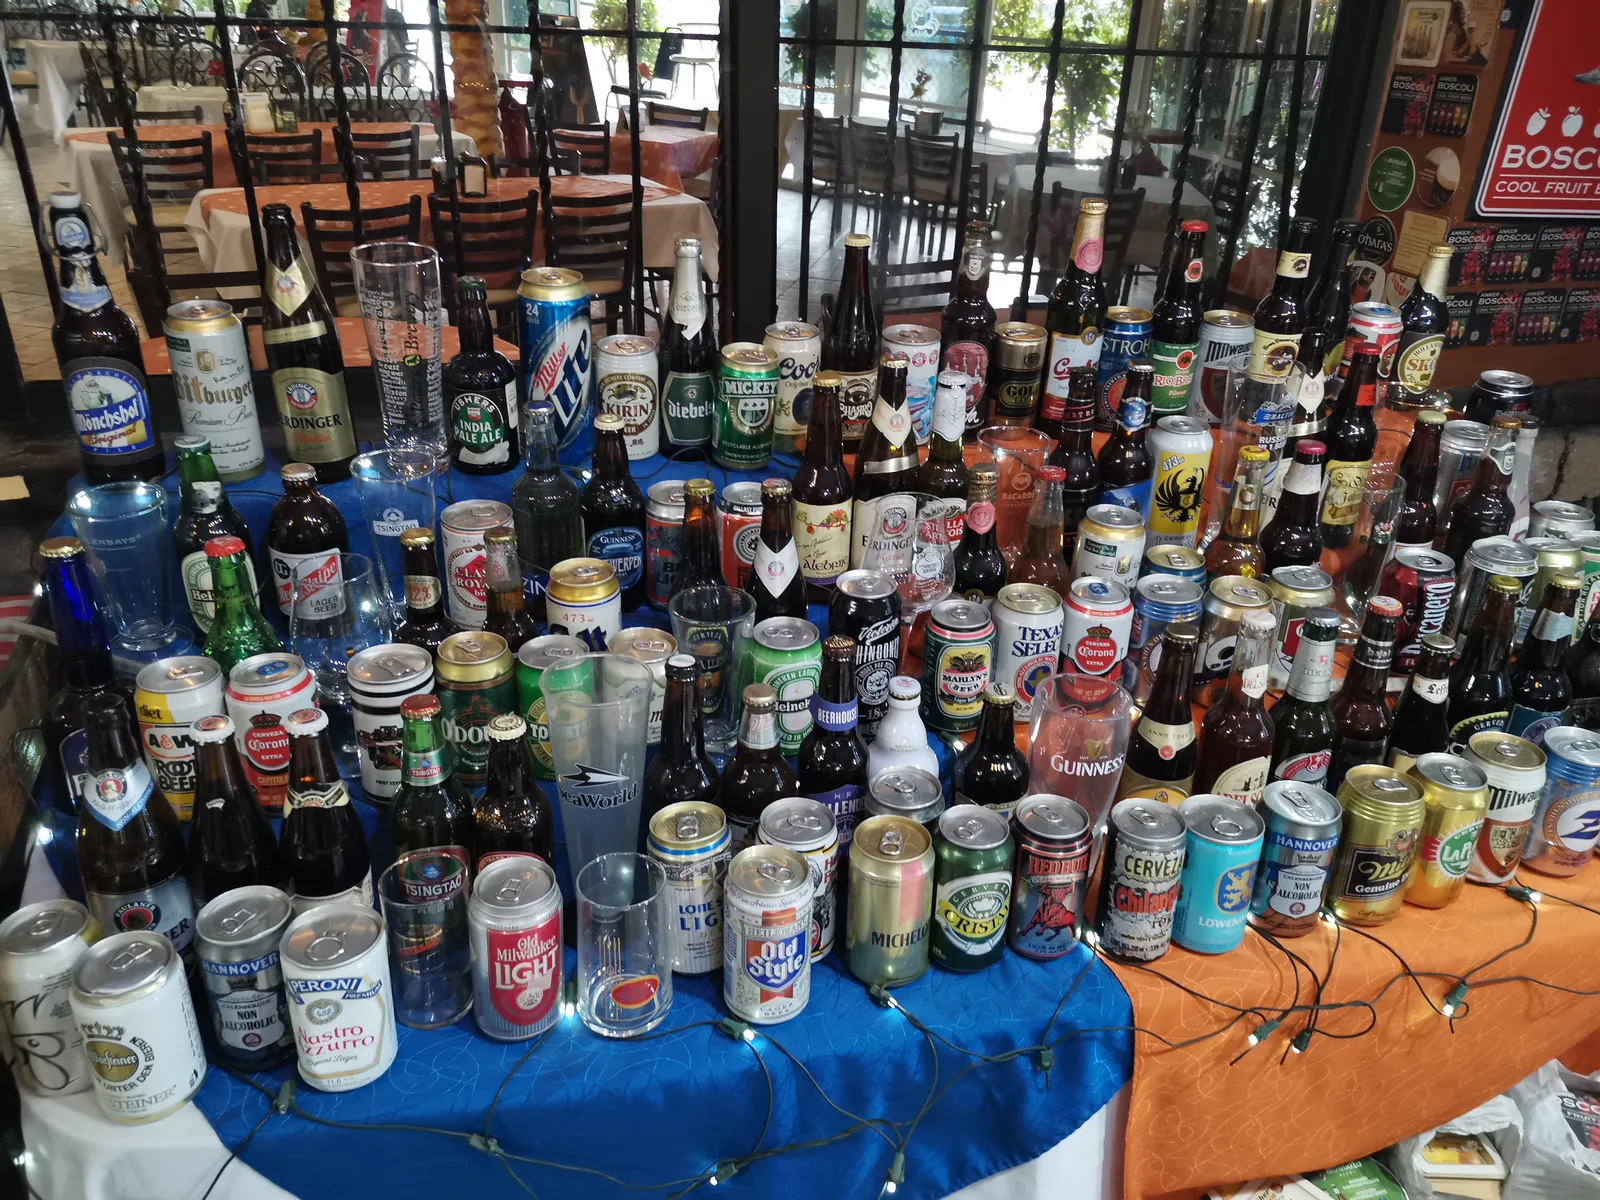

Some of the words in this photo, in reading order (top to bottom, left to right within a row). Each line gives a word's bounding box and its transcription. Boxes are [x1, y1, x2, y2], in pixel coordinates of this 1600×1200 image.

[1393, 81, 1430, 92] BOSCOLI
[1437, 82, 1474, 92] BOSCOLI
[1501, 144, 1600, 170] BOSC
[1495, 180, 1540, 193] COOL
[1544, 182, 1592, 194] FRUIT
[1448, 236, 1490, 244] BOSCOLI
[1496, 234, 1537, 242] BOSCOLI
[1541, 233, 1580, 241] BOSCOLI
[1447, 300, 1473, 308] SCOLI
[1478, 297, 1518, 305] BOSCOLI
[1524, 296, 1563, 304] BOSCOLI
[525, 302, 539, 317] 24
[1102, 337, 1150, 356] STROH
[174, 371, 252, 405] Bitburger
[724, 380, 778, 395] MICKEY
[1154, 375, 1174, 386] RIO
[452, 394, 496, 414] USHERS
[606, 402, 649, 418] KIRIN
[668, 398, 715, 420] Diebels
[75, 398, 139, 433] Mönchshof
[280, 414, 342, 430] ERDINGER
[460, 418, 492, 433] INDIA
[624, 426, 636, 434] EER
[87, 422, 137, 447] Original
[454, 428, 479, 444] PALE
[480, 428, 502, 442] ALE
[1162, 455, 1180, 472] 473
[600, 534, 636, 544] GUINNESS
[192, 590, 214, 600] Hei
[310, 595, 338, 608] LAGER
[314, 604, 337, 613] BEER
[562, 613, 586, 623] 473
[1012, 638, 1058, 657] SELEC
[1078, 645, 1114, 658] Corona
[952, 683, 980, 693] BEER
[139, 705, 164, 720] diet
[252, 730, 284, 739] CERVEZA
[461, 757, 488, 768] Anheuser-
[1050, 754, 1125, 777] GUINNESS
[558, 783, 639, 810] SeaWorld
[1276, 834, 1339, 851] HANNOVER
[404, 874, 462, 896] TSINGTAO
[1293, 882, 1311, 891] NON
[1354, 880, 1401, 894] Genuine
[1276, 889, 1321, 900] ALCOHOLIC
[115, 902, 158, 918] PAULANER
[678, 900, 714, 914] LONE
[680, 912, 719, 930] LIG
[496, 934, 556, 962] Milwaukee
[517, 934, 538, 952] Old
[761, 937, 798, 961] Old
[202, 952, 278, 976] HANNOVER
[494, 945, 559, 990] LIGHT
[748, 954, 804, 984] Style
[290, 978, 359, 994] PERONI
[344, 982, 382, 998] PREMIUM
[760, 1002, 794, 1012] LAGER
[223, 1014, 277, 1031] ALCOHOLIC
[236, 1010, 258, 1020] NON
[298, 1025, 364, 1046] Nastro
[103, 1082, 138, 1092] UNTER
[136, 1064, 154, 1083] DEN
[1566, 1111, 1598, 1122] FRUIT
